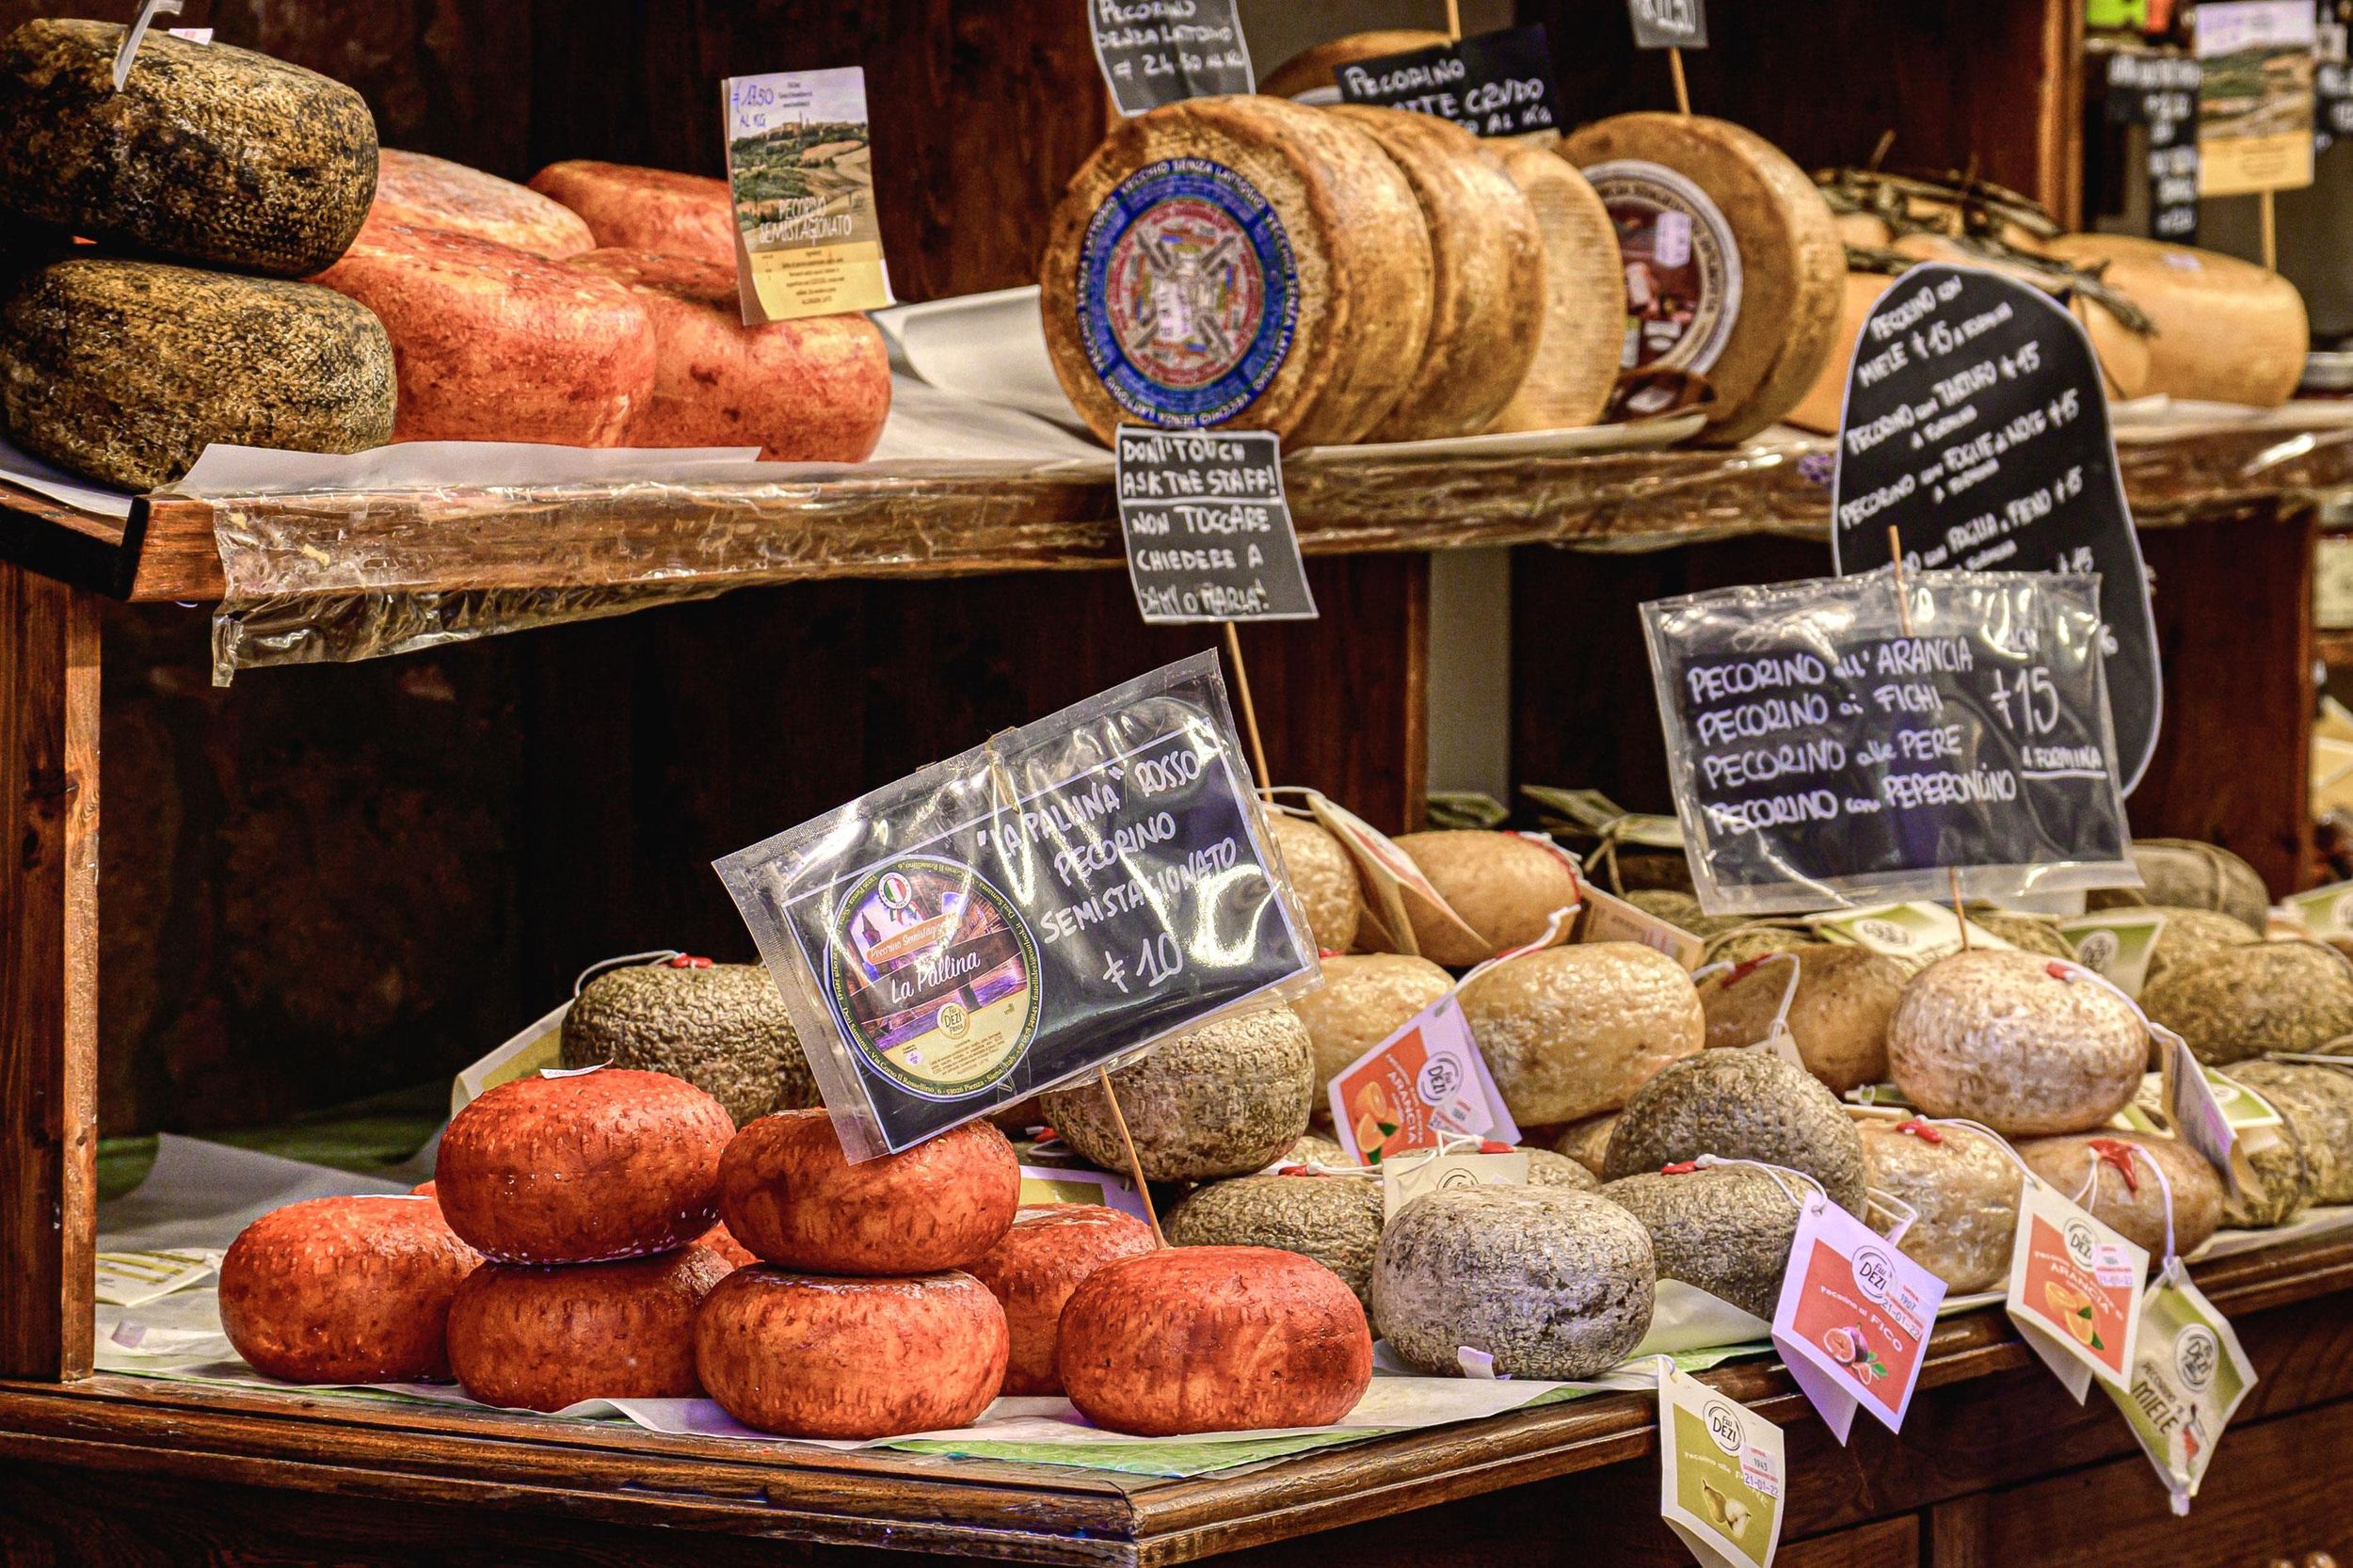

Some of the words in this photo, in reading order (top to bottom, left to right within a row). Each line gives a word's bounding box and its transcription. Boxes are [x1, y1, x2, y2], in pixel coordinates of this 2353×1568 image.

[1123, 471, 1163, 497] ASK
[1162, 469, 1204, 495] THE
[1206, 464, 1277, 496] STAFF!
[1131, 511, 1170, 536] NON
[1174, 504, 1271, 535] TOCCARE
[1136, 549, 1237, 571] CHIEDERE
[1247, 543, 1263, 568] A
[1688, 652, 1826, 704] PECORINO
[1877, 636, 1974, 677] ARANCIA
[1697, 693, 1829, 747] PECORINO
[1872, 684, 1945, 713] FICHI
[1135, 750, 1201, 798] ROSSO
[1704, 738, 1847, 791] PECORINO
[1898, 724, 1964, 761] PERE
[1708, 789, 1839, 836] PECORINO
[1054, 811, 1176, 887] PECORINO
[1040, 837, 1237, 943] SEMISTAIONATO
[891, 979, 914, 1004] La
[918, 950, 981, 993] Pallina
[944, 1013, 962, 1029] DEZI
[849, 1022, 870, 1052] Samanta
[869, 1051, 881, 1064] Via
[878, 1061, 898, 1078] Corso
[1428, 1064, 1447, 1095] DEZI
[1385, 1071, 1417, 1144] ARANCIA
[1859, 1261, 1887, 1290] DEZI
[2050, 1262, 2109, 1315] ARANCIA
[1870, 1313, 1903, 1352] FICO
[1712, 1416, 1737, 1443] DEZI
[2132, 1381, 2180, 1434] MIELE
